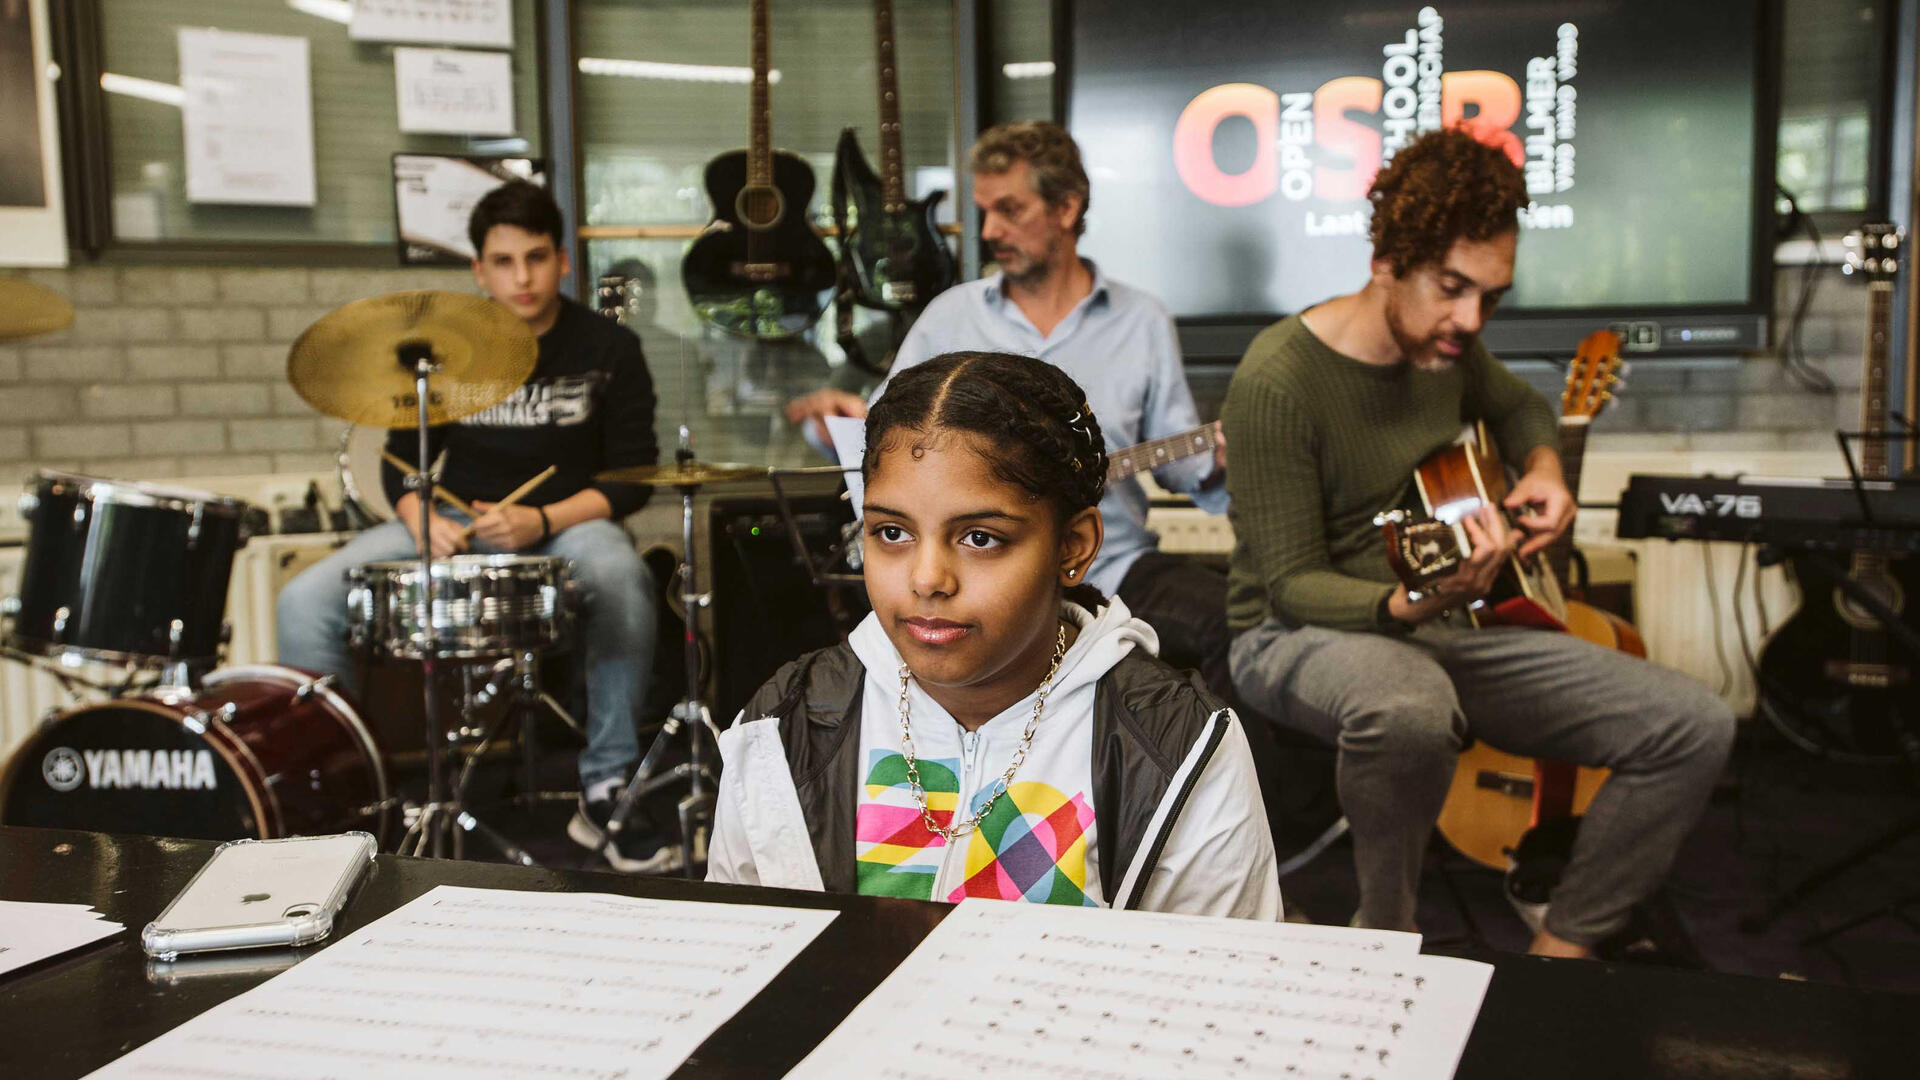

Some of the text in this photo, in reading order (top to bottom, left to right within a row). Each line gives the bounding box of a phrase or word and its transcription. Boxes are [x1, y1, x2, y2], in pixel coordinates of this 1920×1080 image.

[1383, 28, 1418, 168] HOOL
[1417, 6, 1443, 134] ENSCHAP
[1525, 56, 1556, 194] BIJLMER
[1280, 92, 1313, 201] OPEN
[1659, 492, 1762, 518] VA-76
[84, 749, 217, 790] YAMAHA
